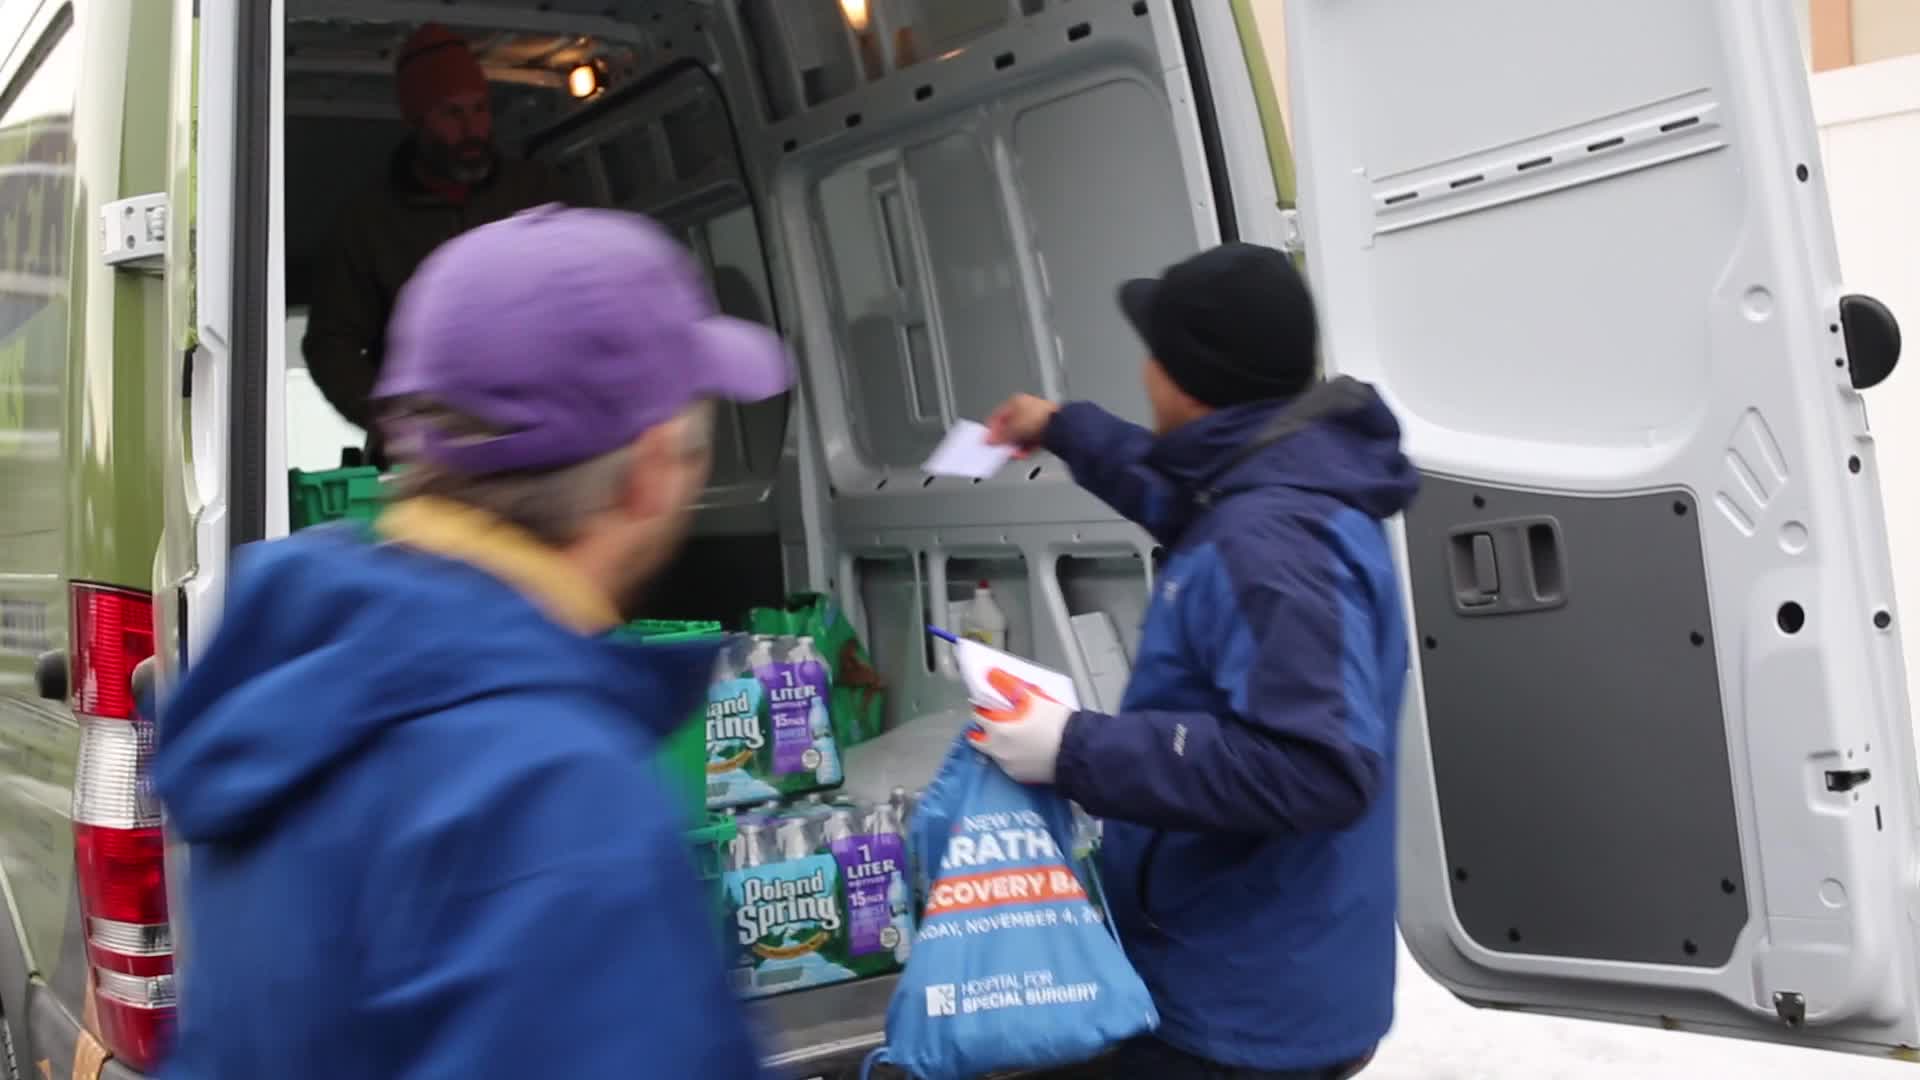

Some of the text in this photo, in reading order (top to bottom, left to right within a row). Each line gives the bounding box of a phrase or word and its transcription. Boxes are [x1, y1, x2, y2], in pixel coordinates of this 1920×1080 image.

[706, 691, 749, 718] and
[771, 685, 817, 701] LITER
[706, 714, 766, 749] ring
[857, 844, 871, 862] 1
[847, 859, 897, 880] LITER
[744, 867, 824, 905] Poland
[736, 894, 841, 945] Spring
[965, 908, 1058, 935] NOVEMBER
[961, 969, 1054, 997] HOSPITAL FOR
[961, 981, 1098, 1014] SPECIAL SURGERY
